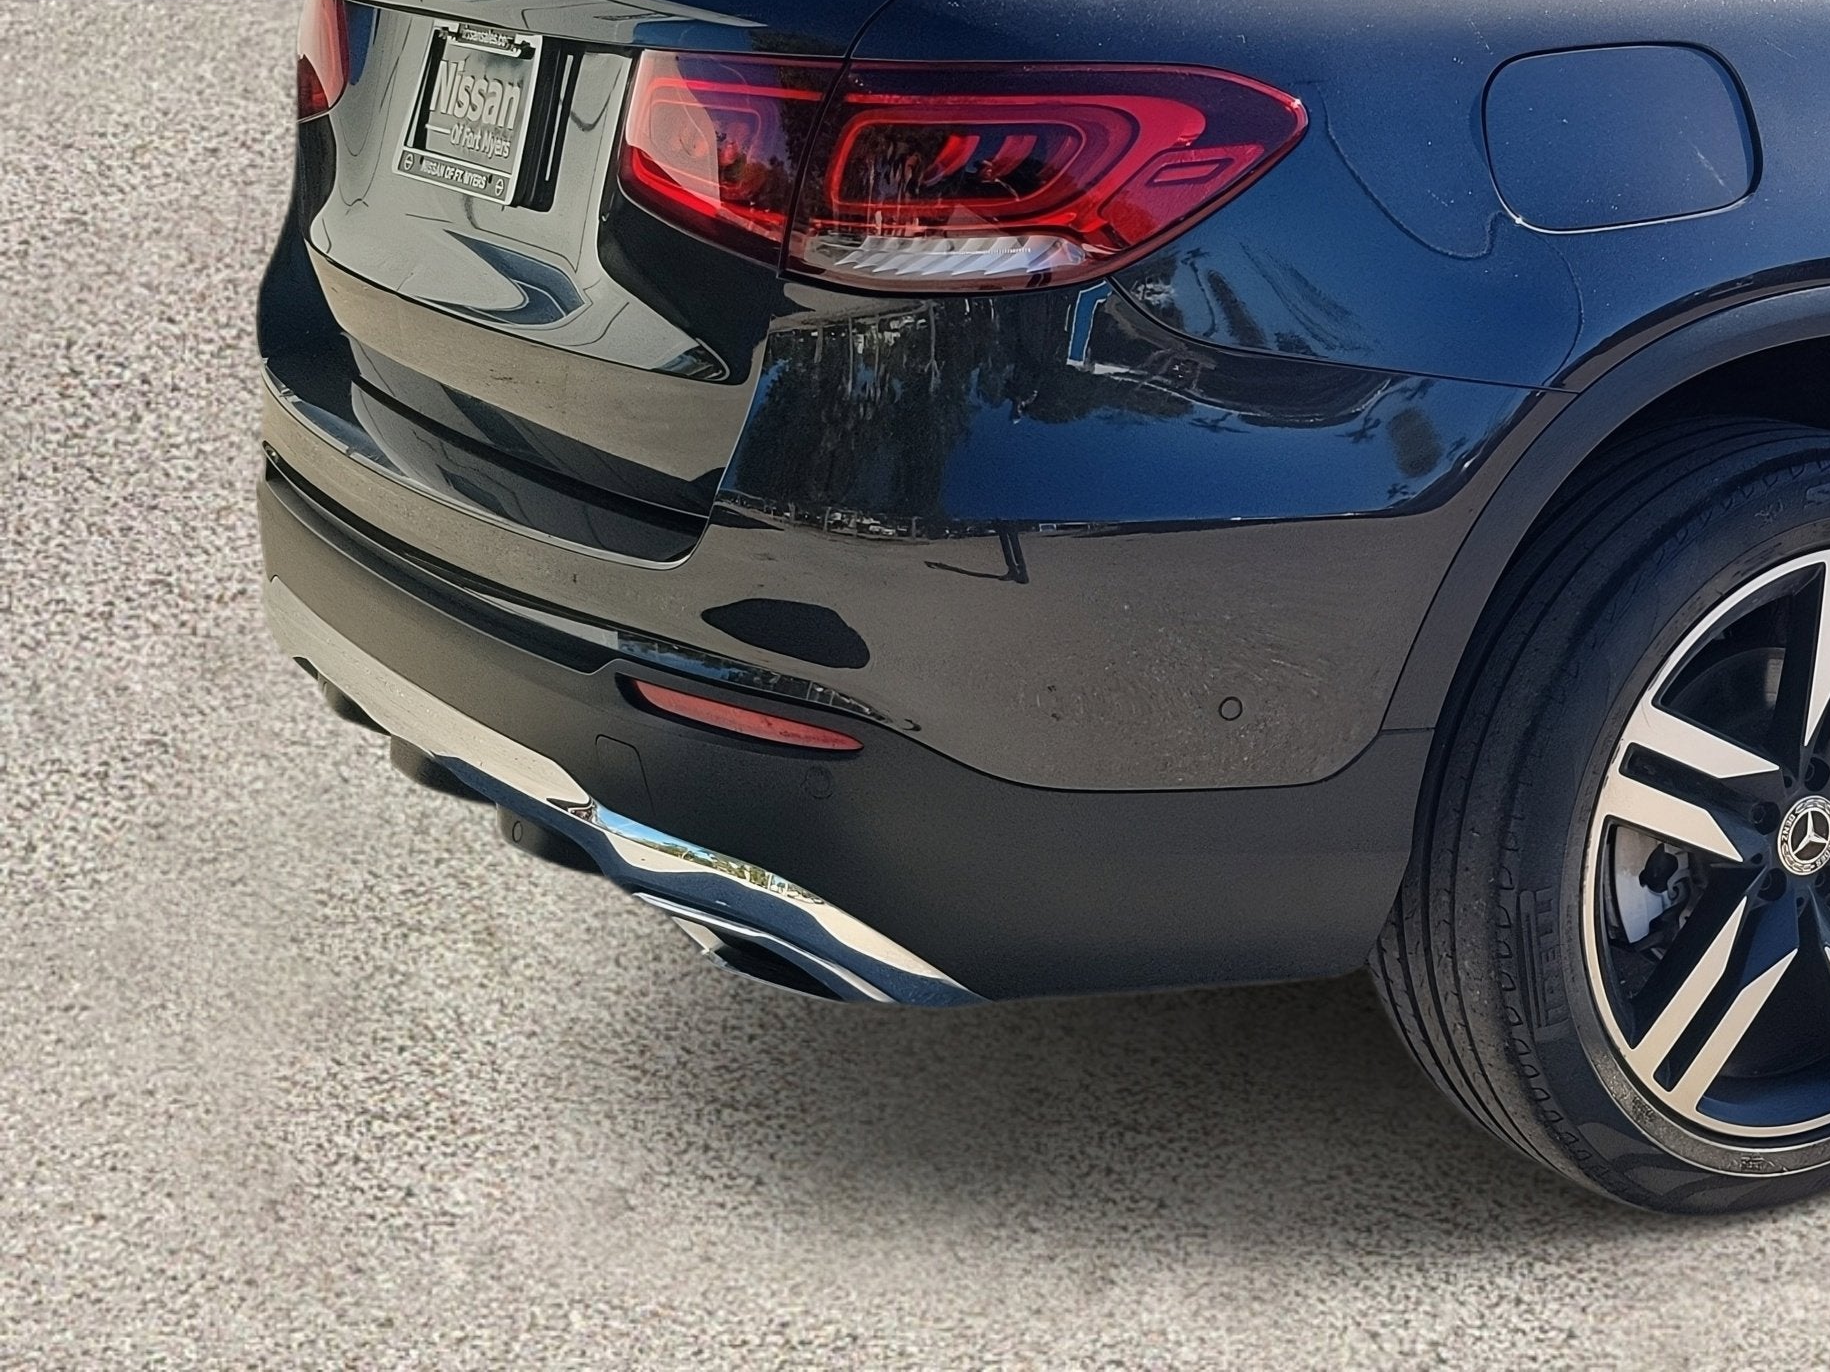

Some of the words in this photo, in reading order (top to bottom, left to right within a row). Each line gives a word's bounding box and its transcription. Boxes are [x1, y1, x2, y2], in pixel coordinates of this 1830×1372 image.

[430, 59, 521, 130] Nissan
[462, 128, 481, 151] Fort
[481, 129, 511, 159] Myers
[420, 158, 445, 177] NISSAN
[444, 165, 455, 180] OF
[463, 172, 487, 189] MYERS
